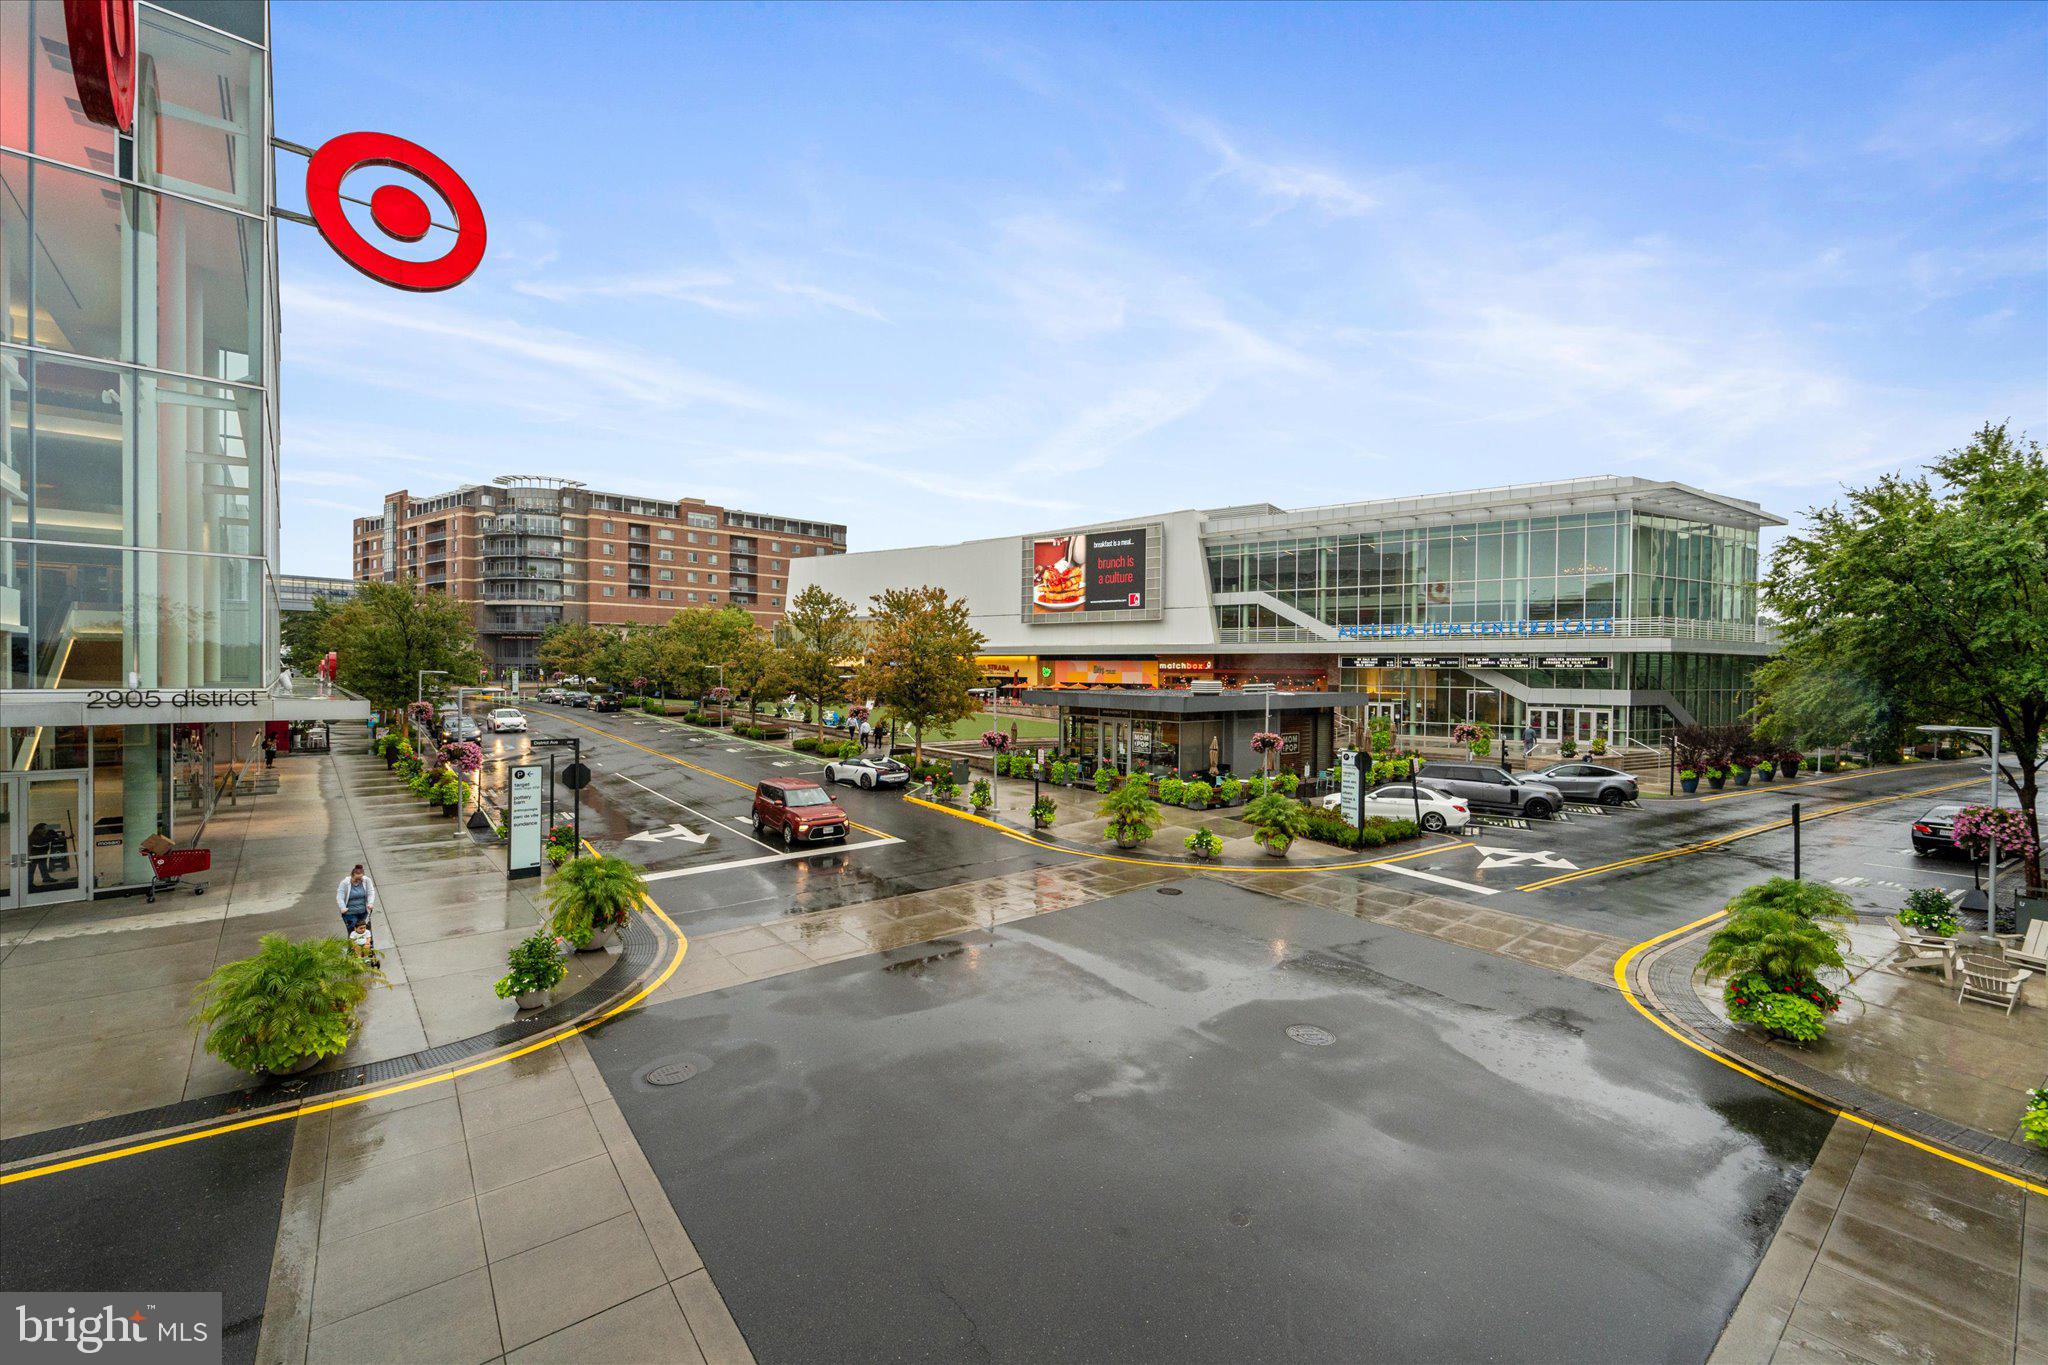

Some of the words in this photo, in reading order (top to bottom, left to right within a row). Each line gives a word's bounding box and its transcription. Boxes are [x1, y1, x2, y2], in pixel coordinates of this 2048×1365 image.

[1098, 556, 1126, 570] brunch
[1127, 555, 1134, 567] is
[1098, 575, 1103, 584] a
[1104, 572, 1133, 584] culture
[1338, 624, 1416, 638] ANGELIKA
[1423, 622, 1461, 636] FILM
[1470, 619, 1539, 635] CENTER
[1545, 621, 1555, 634] &
[987, 664, 1010, 672] STRADA
[1159, 662, 1203, 670] matchbox
[86, 690, 161, 709] 2905
[172, 689, 258, 708] district
[1282, 735, 1298, 743] MOM
